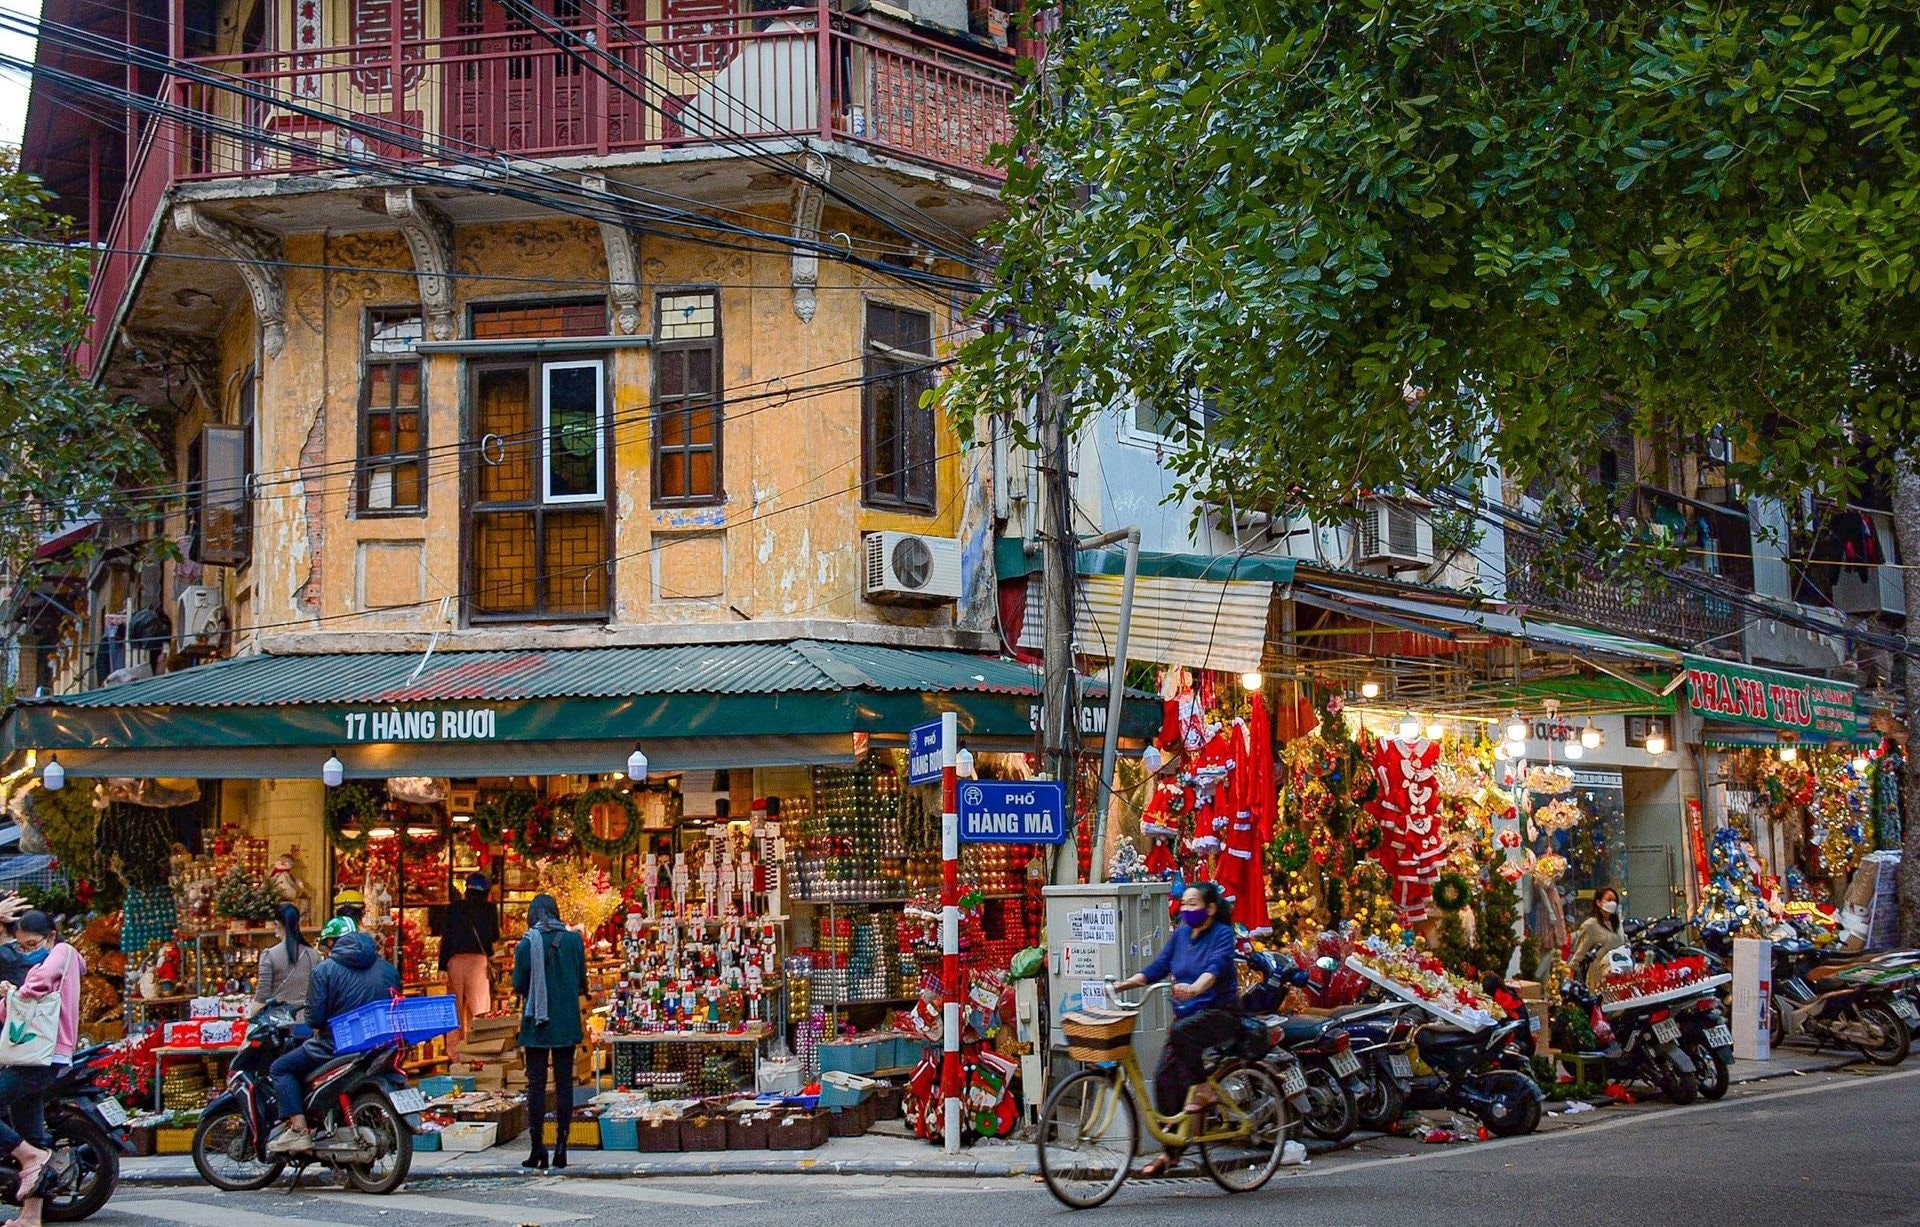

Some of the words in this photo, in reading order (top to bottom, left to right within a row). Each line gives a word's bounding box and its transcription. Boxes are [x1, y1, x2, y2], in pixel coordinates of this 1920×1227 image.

[1687, 668, 1767, 719] THANH
[1769, 683, 1812, 727] THƯ
[345, 713, 367, 740] 17
[372, 706, 435, 740] HÀNG
[442, 708, 495, 739] RƯƠI
[924, 729, 937, 747] PHỐ
[911, 751, 929, 776] HÀNG
[1005, 790, 1035, 805] PHỐ
[968, 808, 1018, 834] HÀNG
[1024, 809, 1053, 834] MÃ
[1083, 912, 1099, 925] MUA
